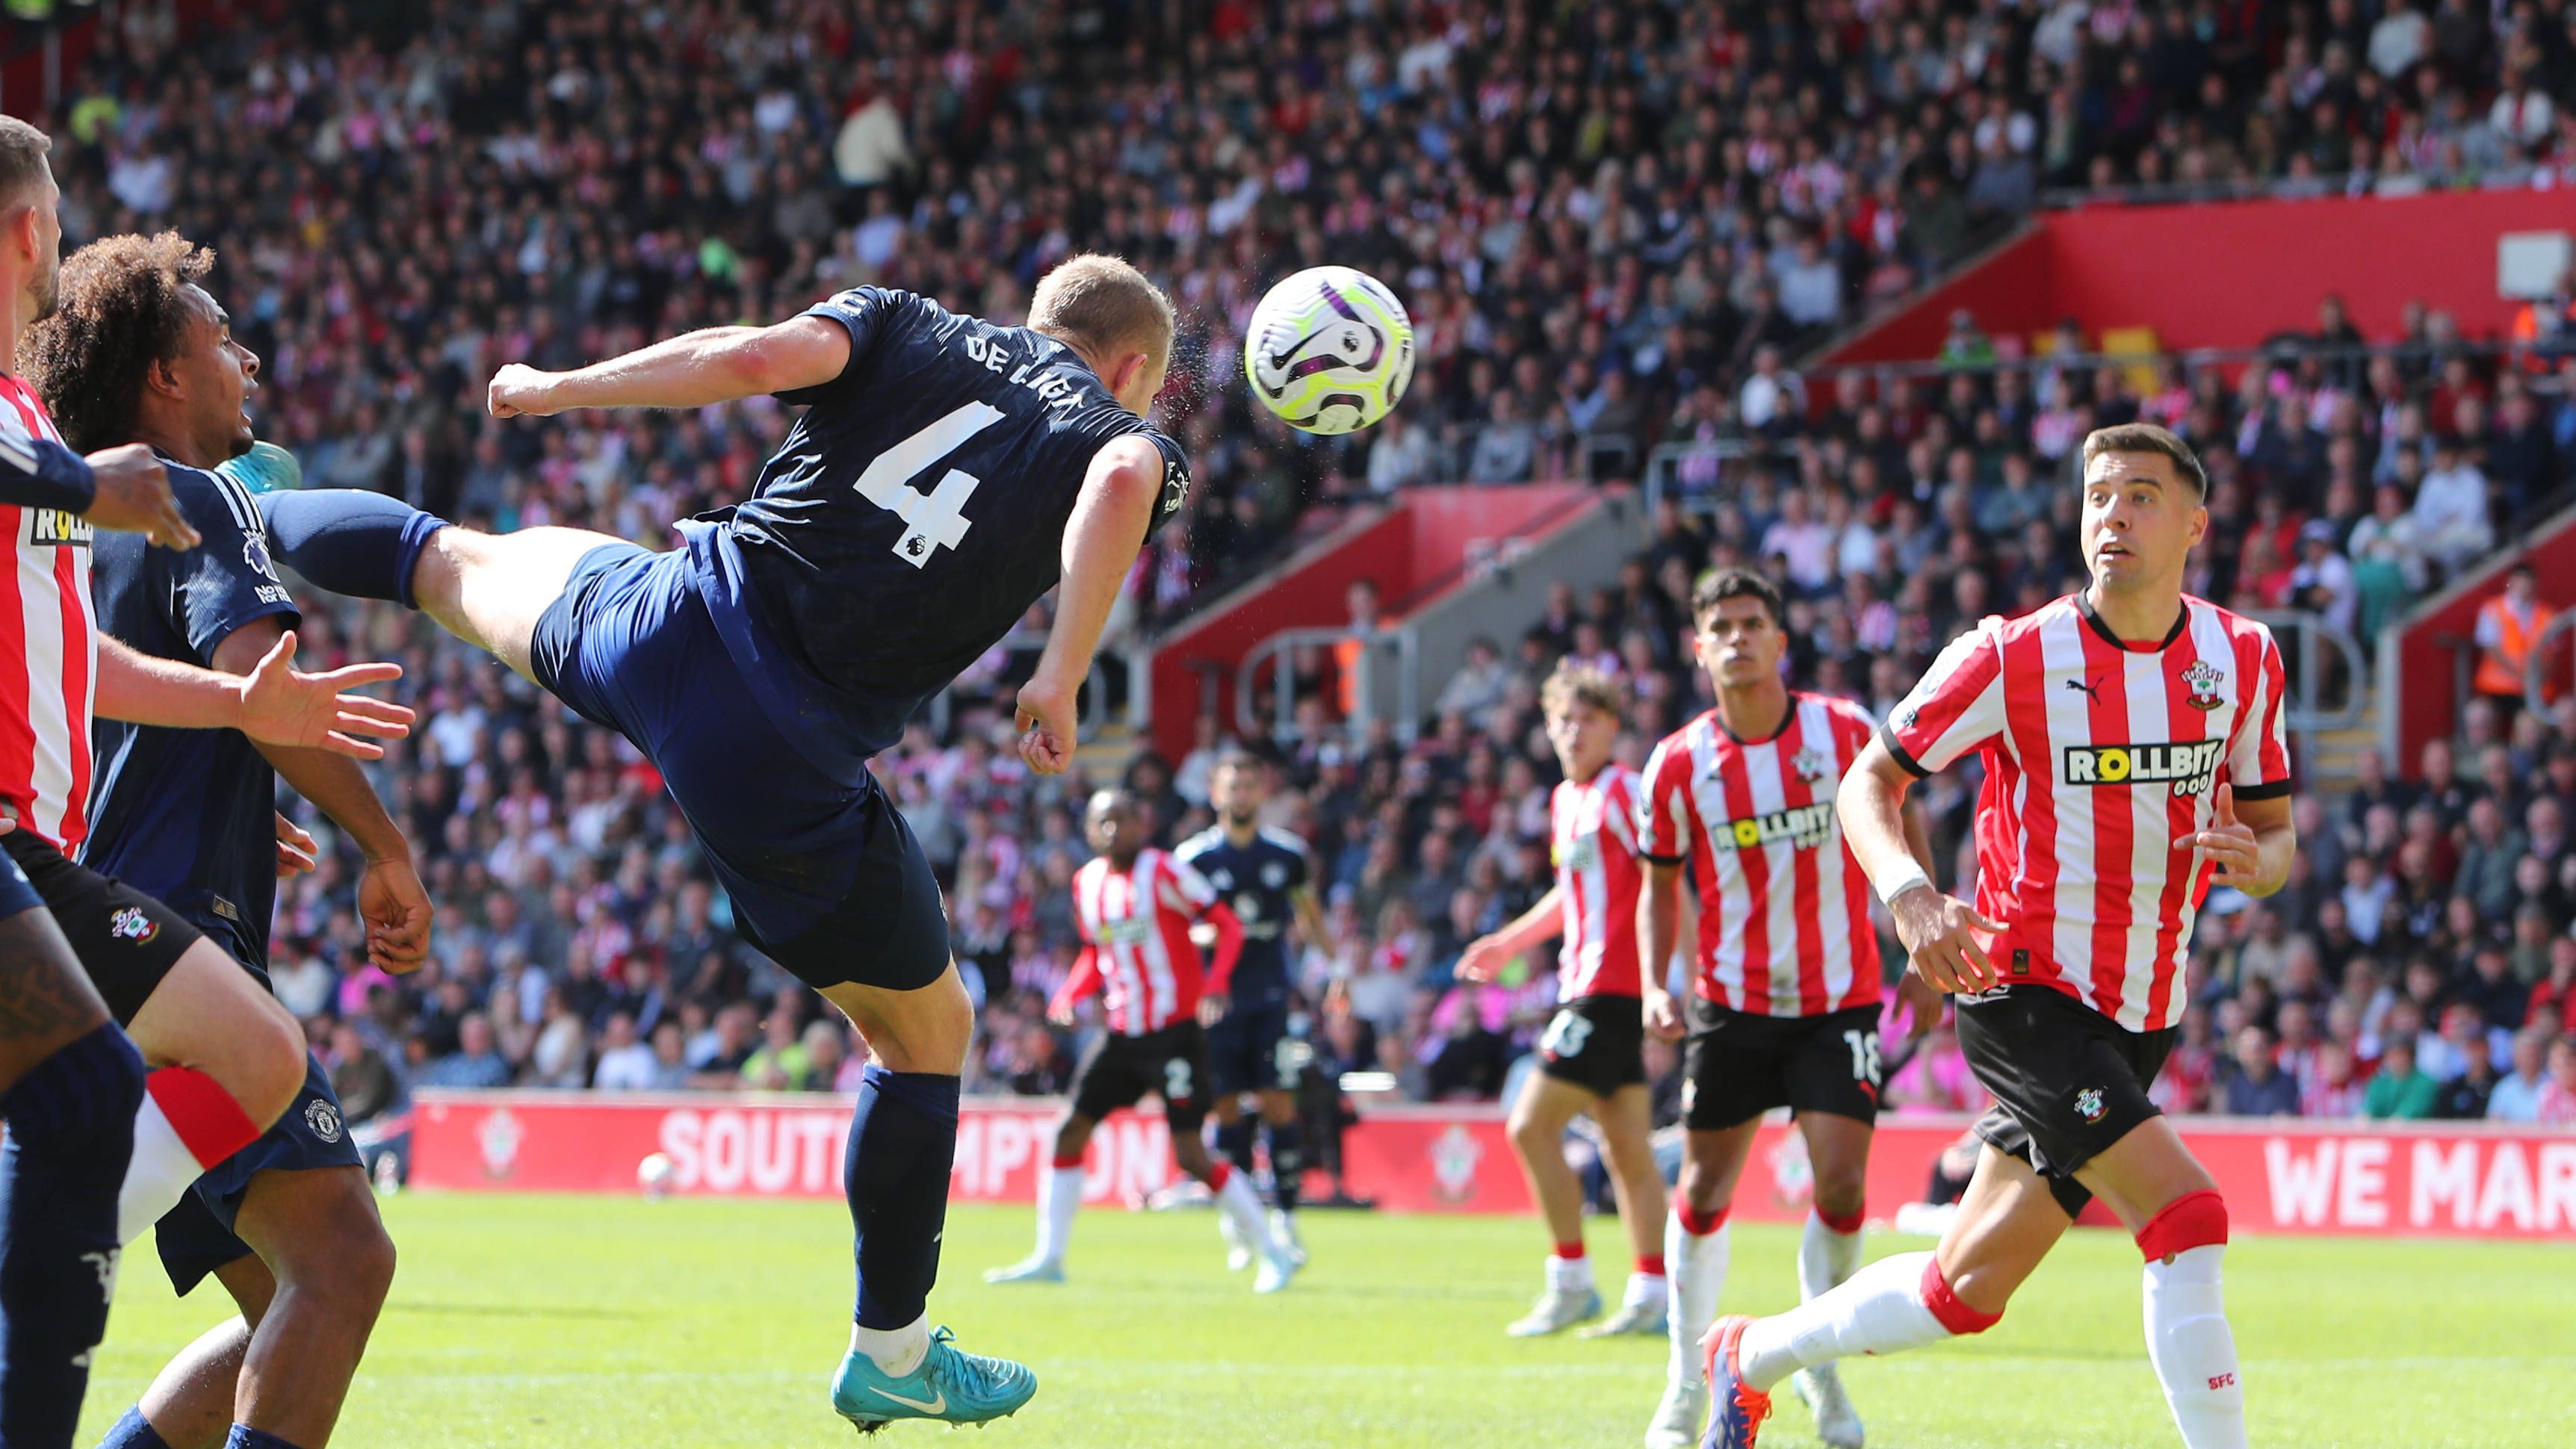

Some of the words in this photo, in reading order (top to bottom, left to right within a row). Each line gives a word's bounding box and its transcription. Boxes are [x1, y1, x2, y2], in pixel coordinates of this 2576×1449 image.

[965, 335, 1009, 374] DE
[852, 400, 1006, 569] 4
[2069, 741, 2219, 783] ROLLBIT
[1715, 804, 1830, 852] ROLLBIT
[1163, 1057, 1194, 1099] 2
[2263, 1138, 2389, 1227] WE
[2208, 1372, 2235, 1390] SFC
